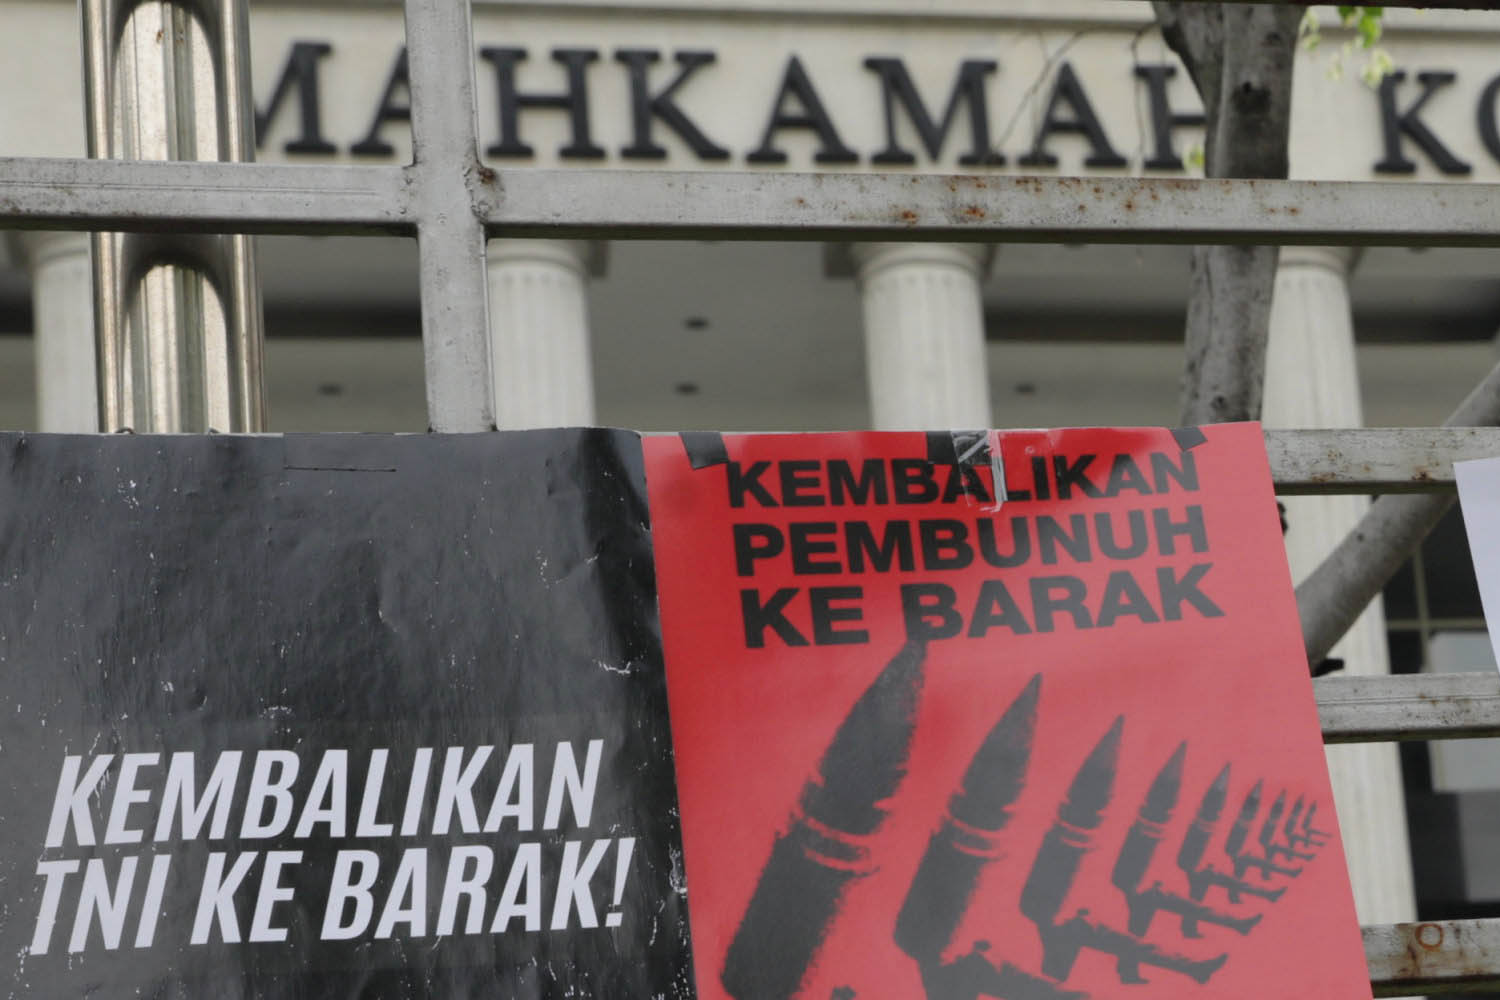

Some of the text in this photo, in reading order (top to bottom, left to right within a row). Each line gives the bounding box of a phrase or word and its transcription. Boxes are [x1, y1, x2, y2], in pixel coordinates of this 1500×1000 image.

[726, 451, 1201, 510] KEMBALIKAN
[732, 505, 1210, 578] PEMBUNUH
[739, 563, 1226, 650] KE BARAK
[45, 739, 604, 849] KEMBALIKAN
[29, 837, 636, 956] TNI KE BARAK!
